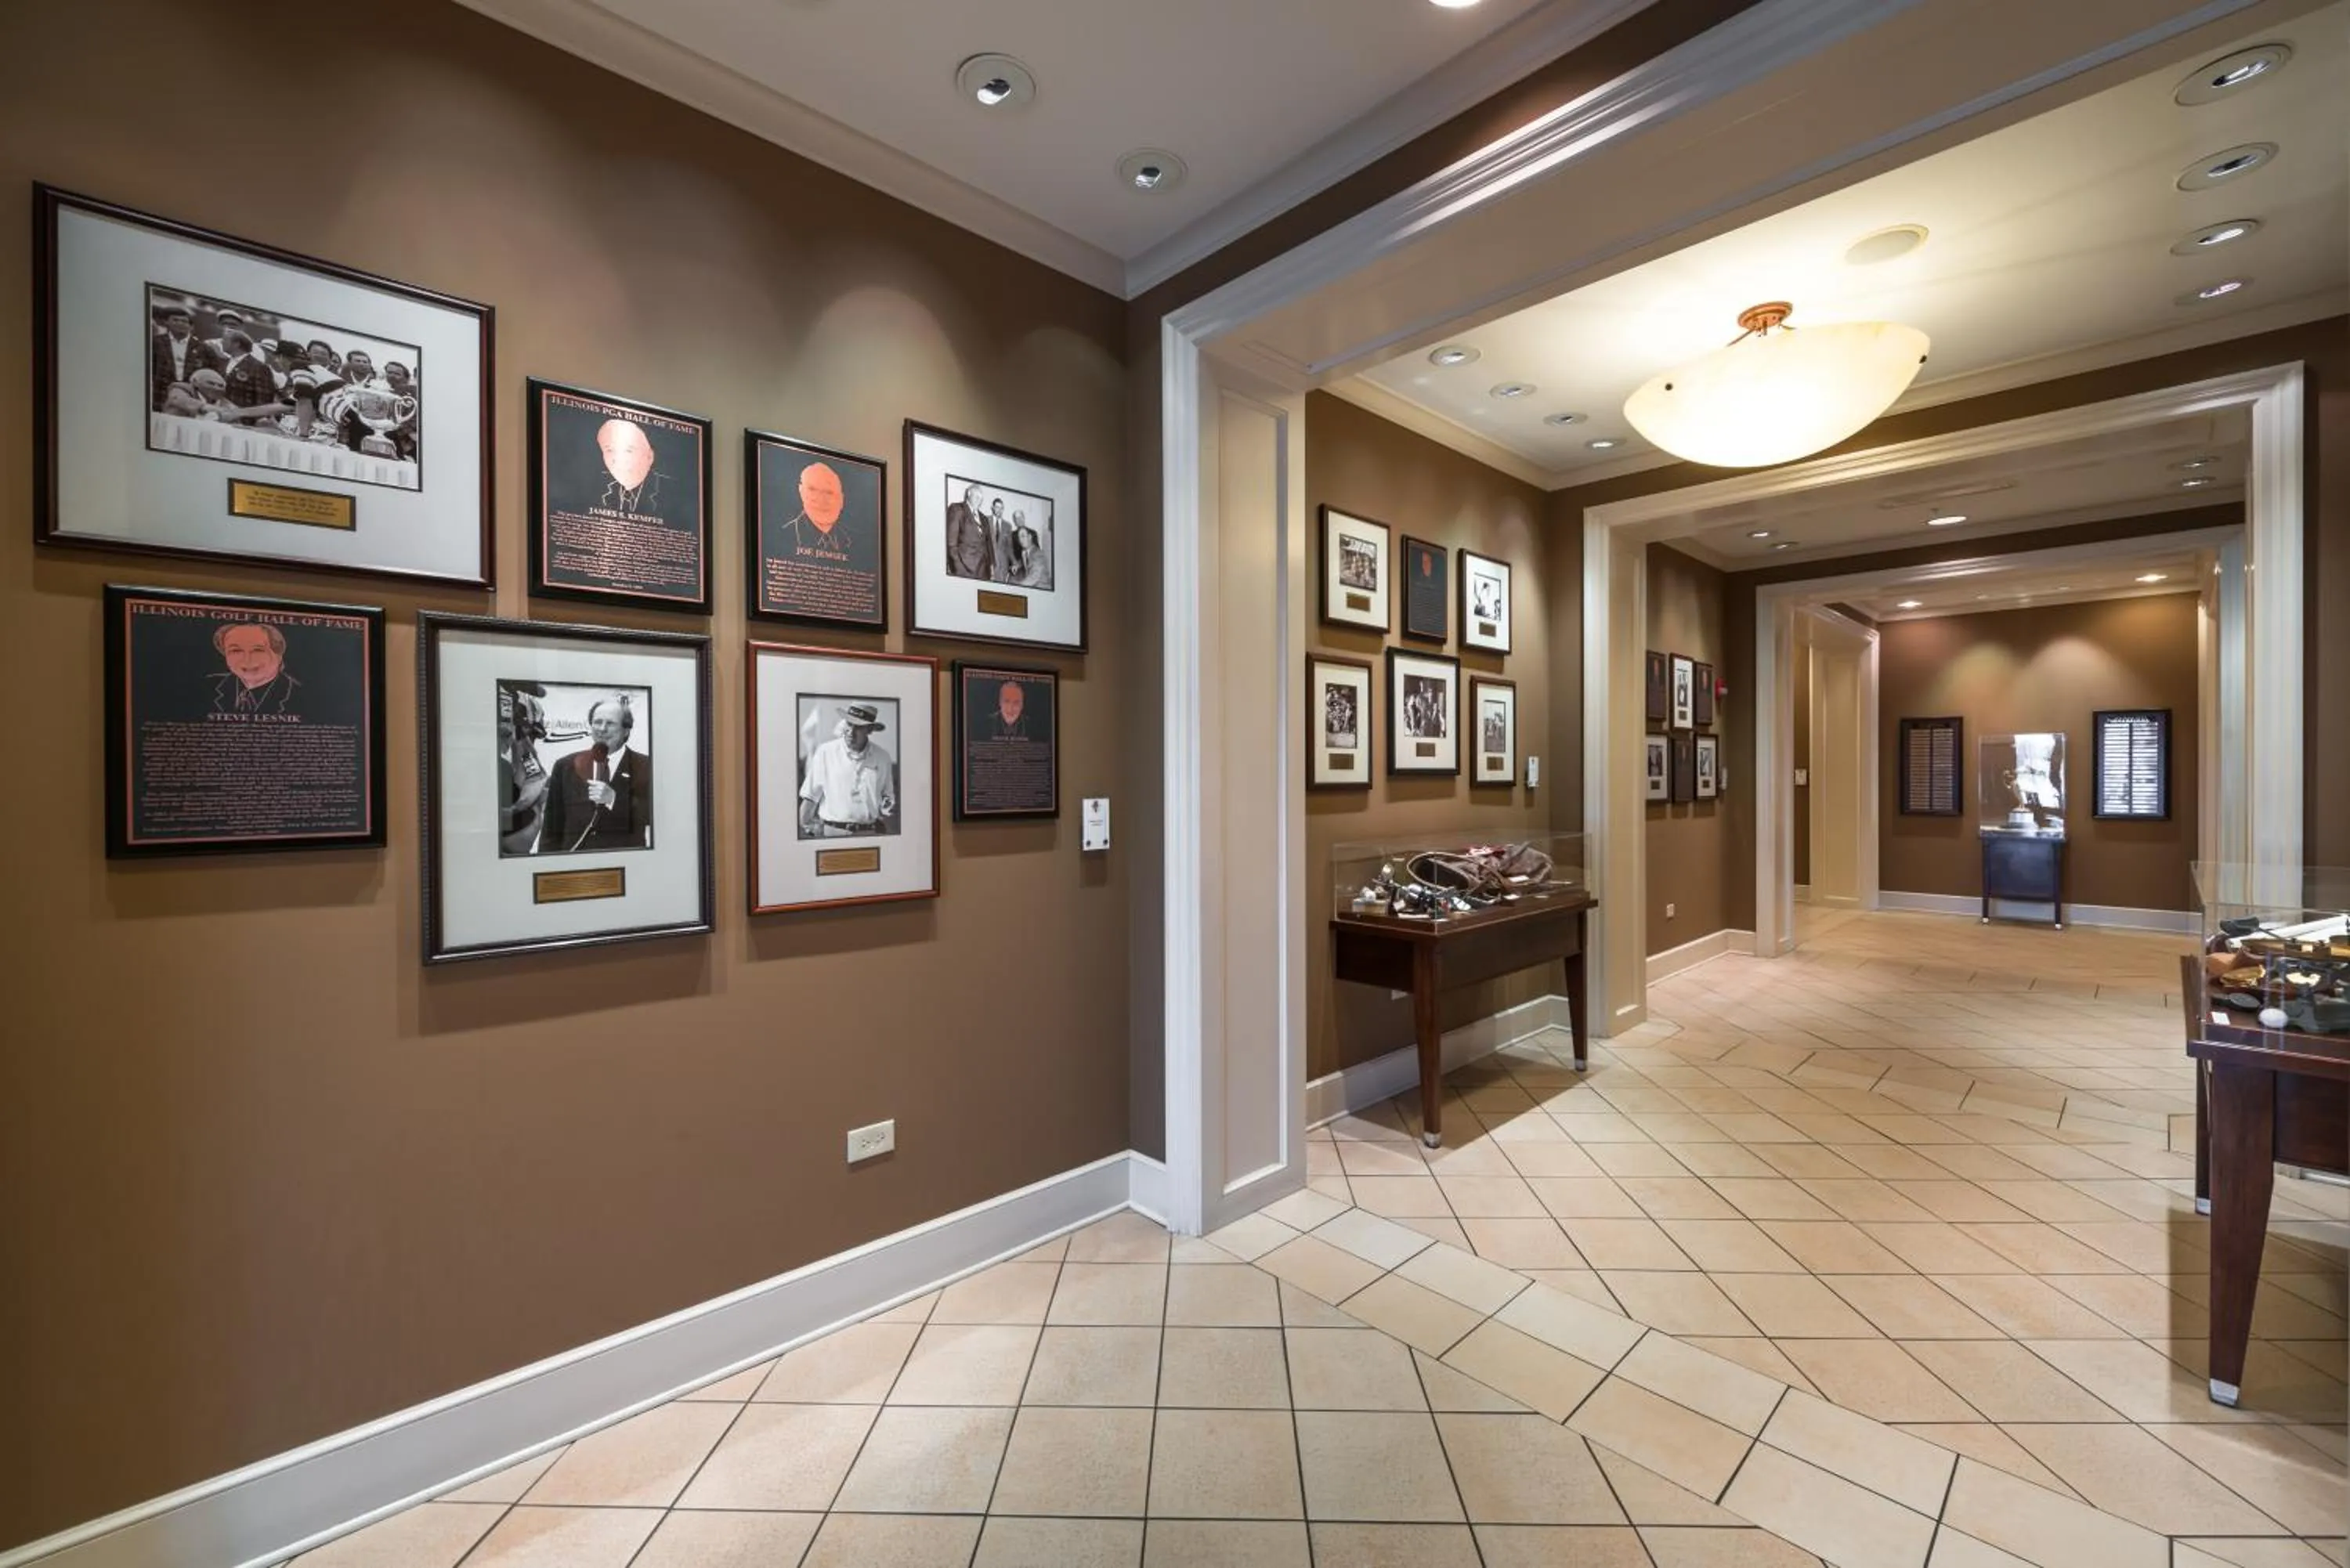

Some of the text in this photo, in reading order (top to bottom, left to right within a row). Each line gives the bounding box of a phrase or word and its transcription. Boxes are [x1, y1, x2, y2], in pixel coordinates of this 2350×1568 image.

[551, 396, 694, 434] ILLINOIS PGA HALL OF FAME
[589, 507, 617, 517] JAMES
[627, 513, 663, 525] KEMPER
[796, 547, 815, 556] JOE
[132, 604, 363, 630] ILLINOIS GOLF HALL OF FAME
[207, 713, 301, 723] STEVE LESNIK
